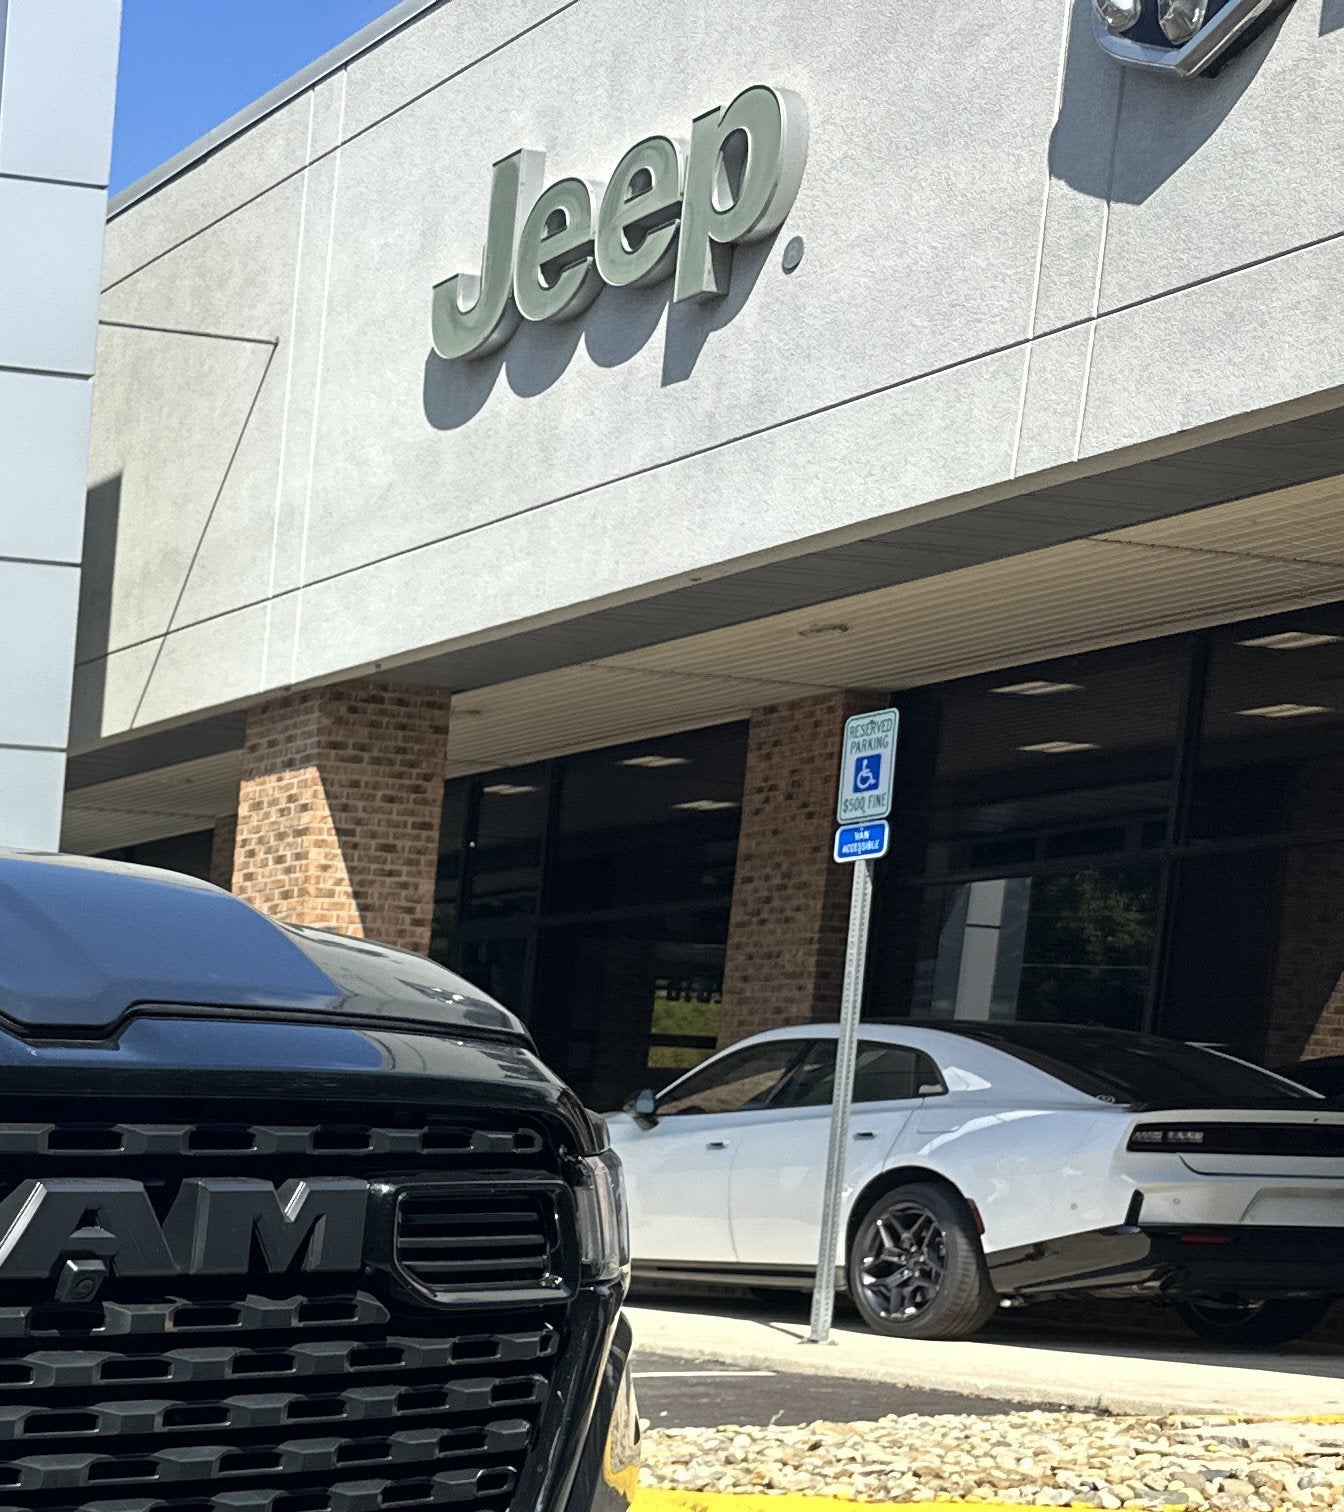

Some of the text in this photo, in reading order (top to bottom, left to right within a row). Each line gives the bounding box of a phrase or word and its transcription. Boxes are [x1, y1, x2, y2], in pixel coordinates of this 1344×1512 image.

[431, 84, 806, 360] Jeep
[849, 718, 893, 739] RESERVED
[849, 735, 889, 755] PARKING
[867, 792, 887, 809] FINE
[853, 830, 870, 840] VAN
